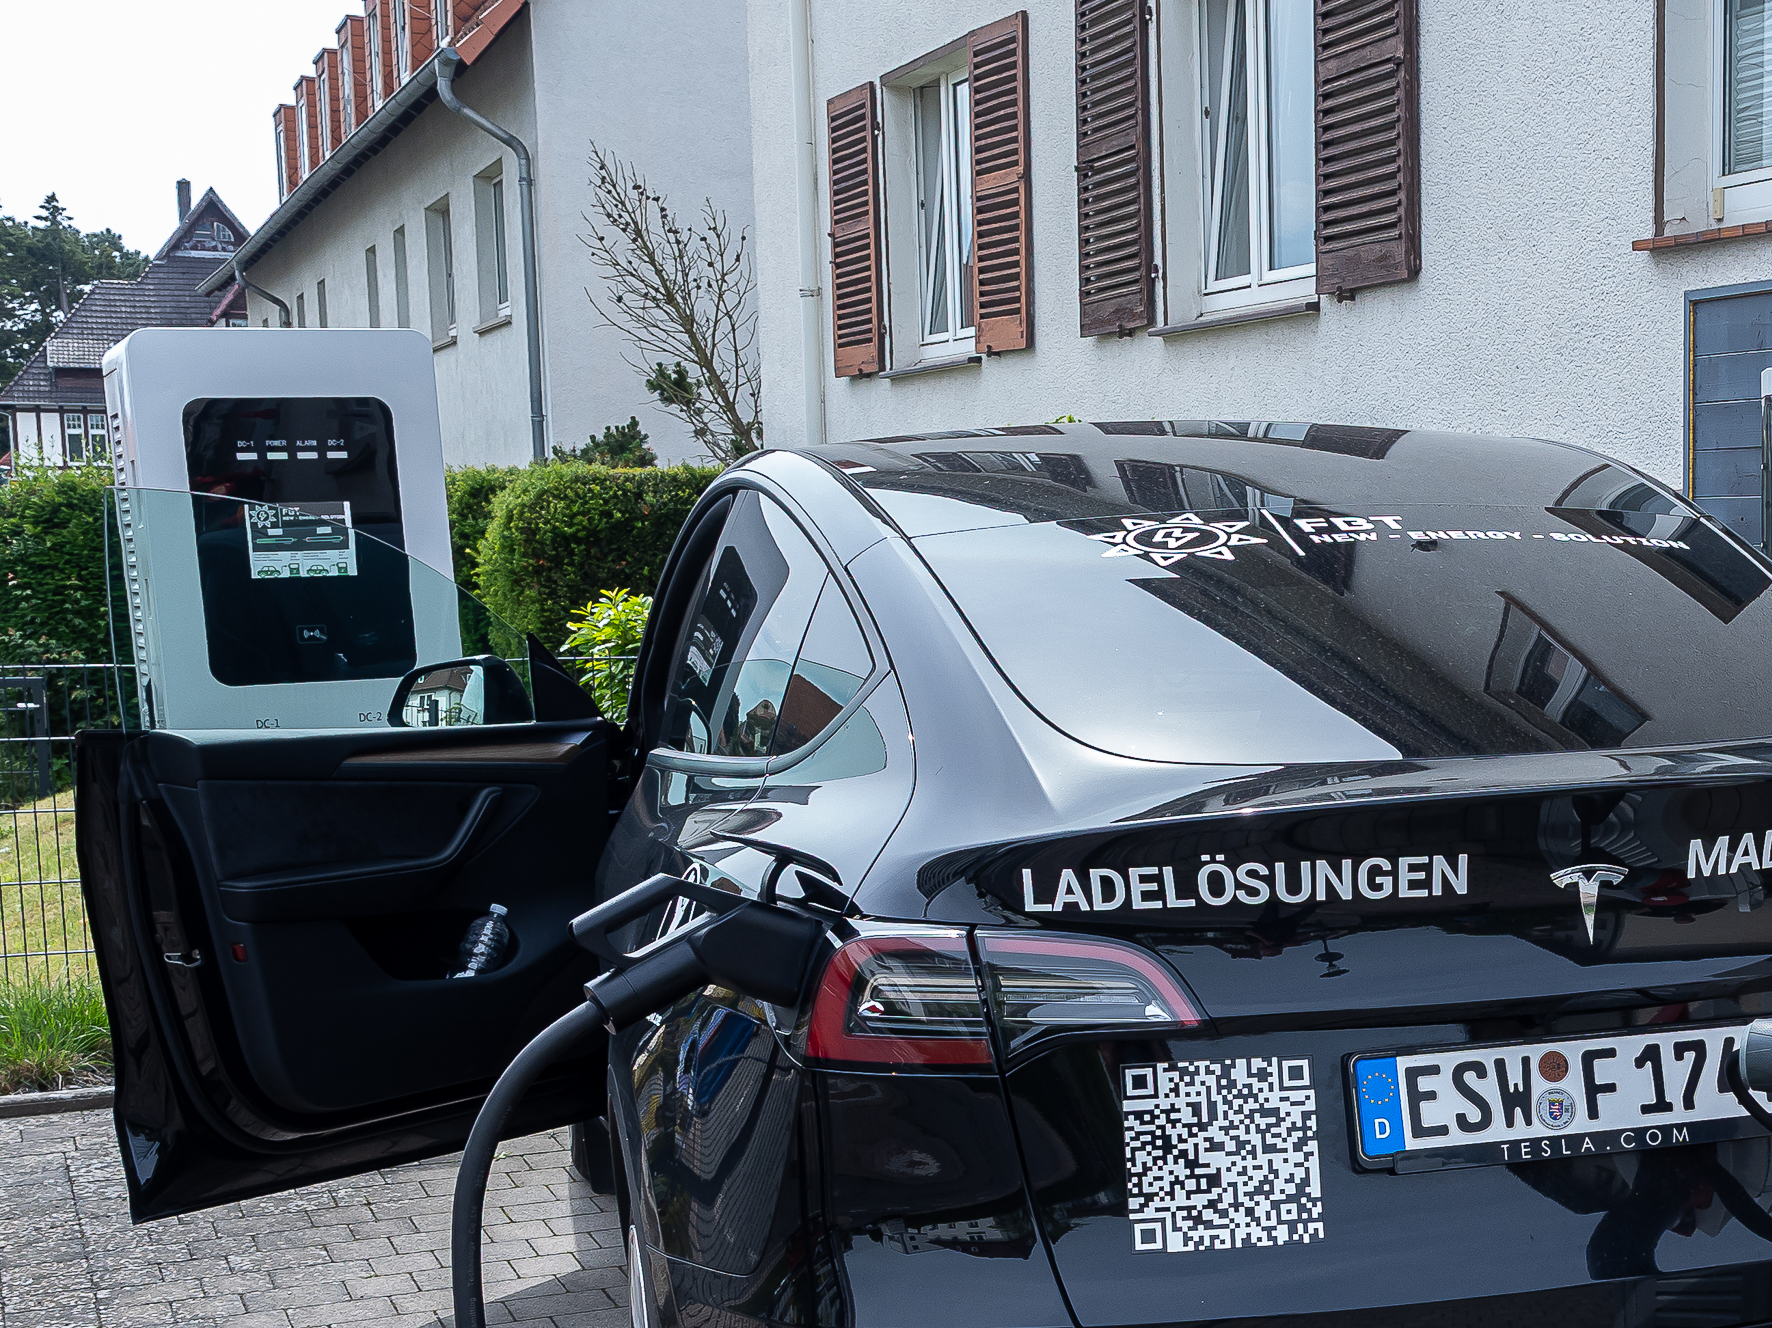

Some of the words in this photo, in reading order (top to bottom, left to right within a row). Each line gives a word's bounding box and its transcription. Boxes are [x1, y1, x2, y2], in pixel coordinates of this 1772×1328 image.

[1293, 516, 1403, 531] FBT
[1308, 532, 1379, 545] NEW
[1408, 529, 1522, 541] ENERGY
[1549, 531, 1690, 551] SOLUTION
[256, 719, 280, 729] DC-1
[359, 712, 382, 722] DC-2
[1021, 854, 1469, 912] LADELÖSUNGEN
[1404, 1055, 1534, 1139] ESW
[1580, 1047, 1617, 1121] F
[1375, 1118, 1390, 1140] D
